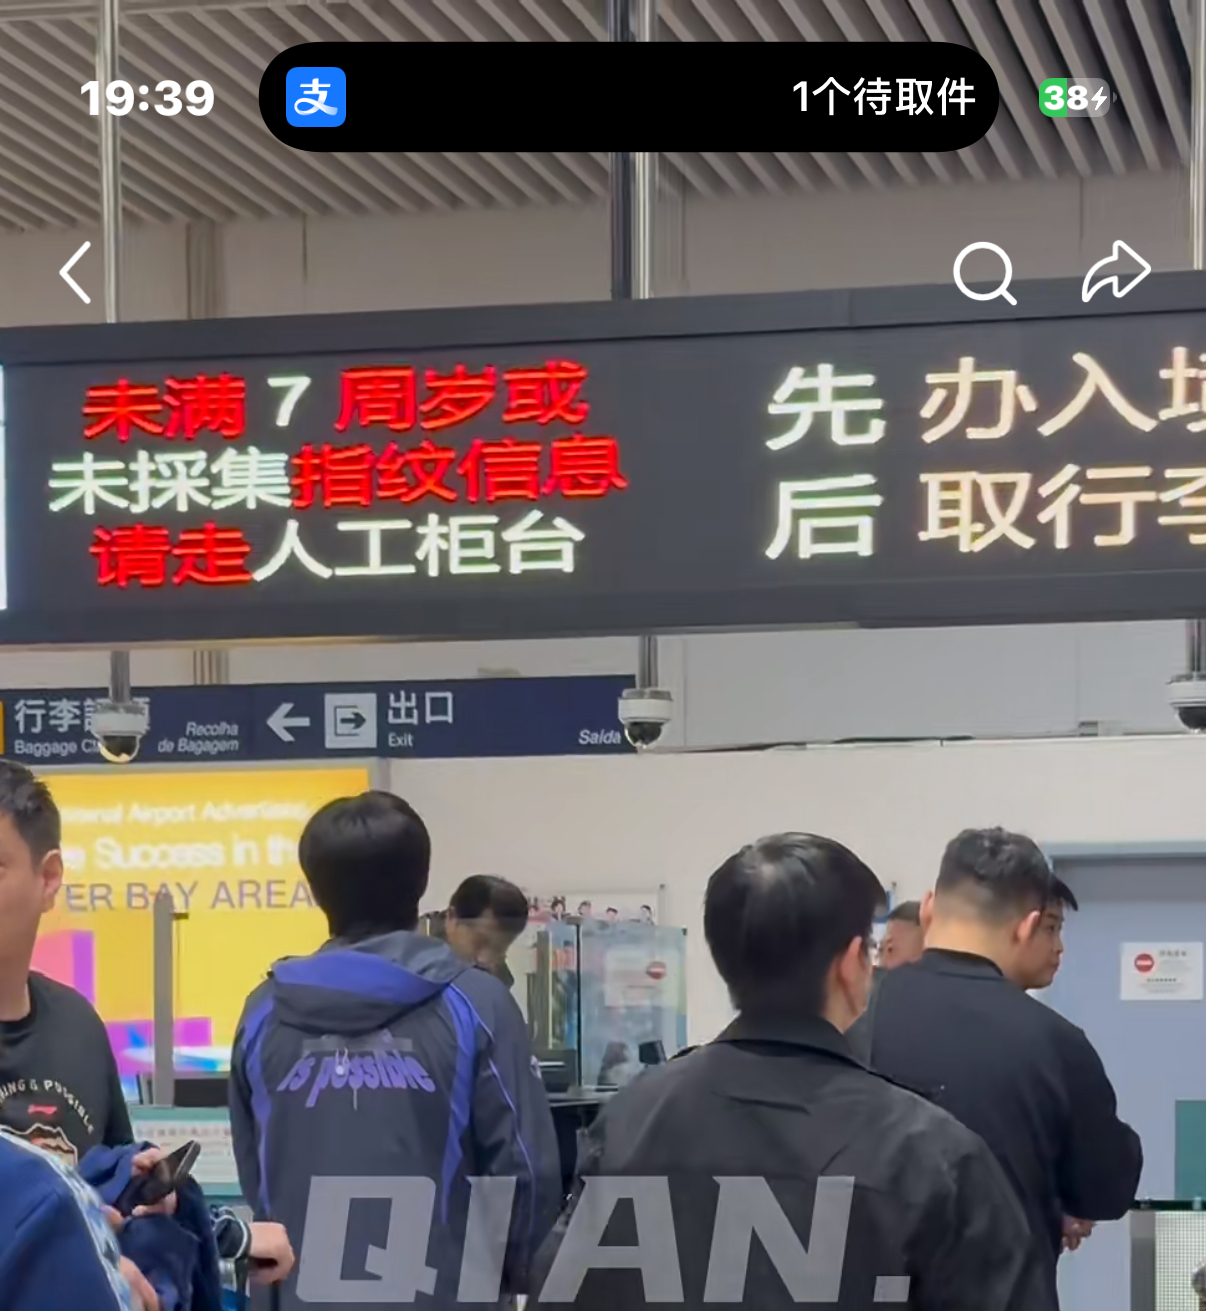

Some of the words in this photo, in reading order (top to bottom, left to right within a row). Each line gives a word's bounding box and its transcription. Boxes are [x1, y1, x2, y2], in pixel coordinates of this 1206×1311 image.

[82, 372, 246, 441] 未满
[266, 375, 312, 428] 7
[334, 360, 590, 431] 周岁或
[764, 362, 887, 451] 先
[47, 433, 629, 517] 未採集指纹信息
[764, 473, 884, 560] 后
[89, 509, 586, 587] 请走人工柜台
[387, 690, 454, 726] 出口
[157, 738, 175, 753] de
[178, 737, 239, 755] Bagagem
[185, 721, 239, 737] Recolha
[388, 732, 413, 747] Exit
[14, 739, 77, 757] Baggage
[95, 837, 226, 872] Success
[126, 879, 199, 909] BAY
[210, 878, 316, 909] AREA
[305, 1050, 437, 1109] possible
